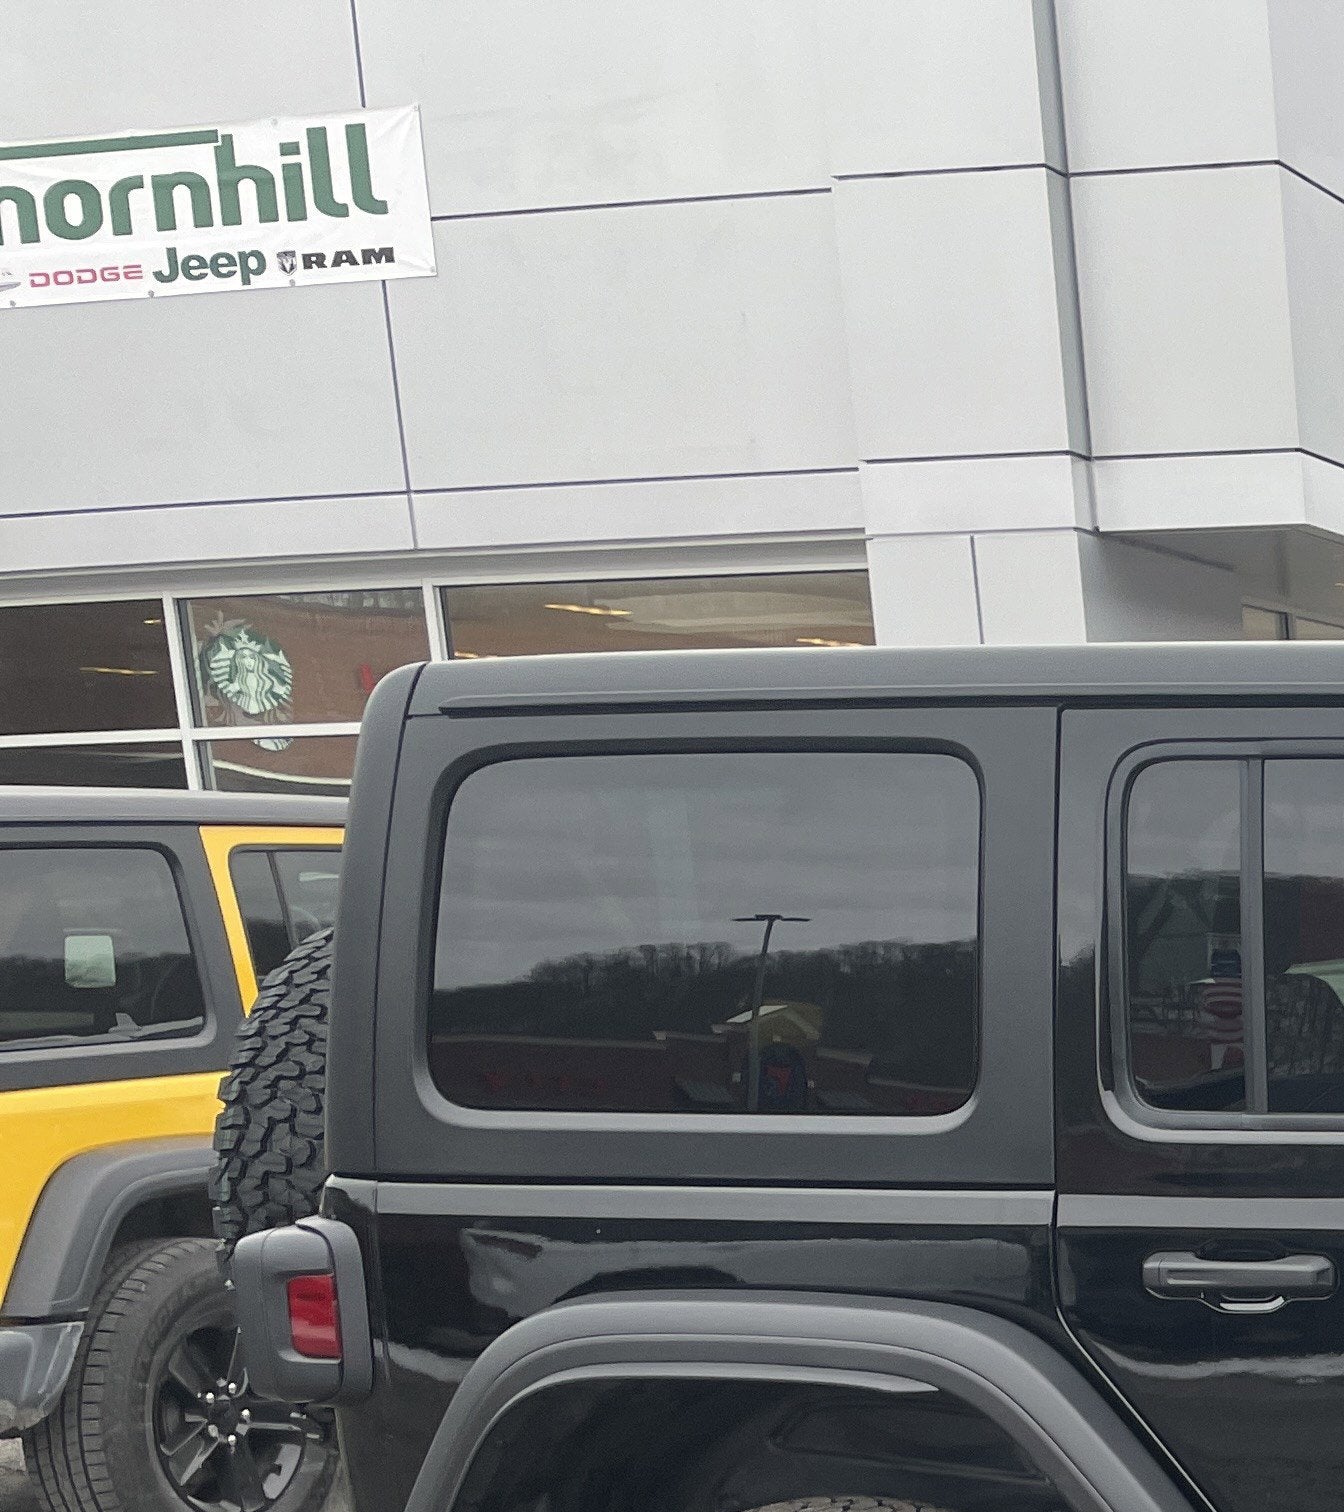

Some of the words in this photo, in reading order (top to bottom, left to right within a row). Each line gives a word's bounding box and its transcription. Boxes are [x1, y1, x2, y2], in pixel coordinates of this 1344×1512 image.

[29, 264, 143, 288] DODGE
[152, 247, 267, 286] Jeep
[301, 247, 396, 271] RAM
